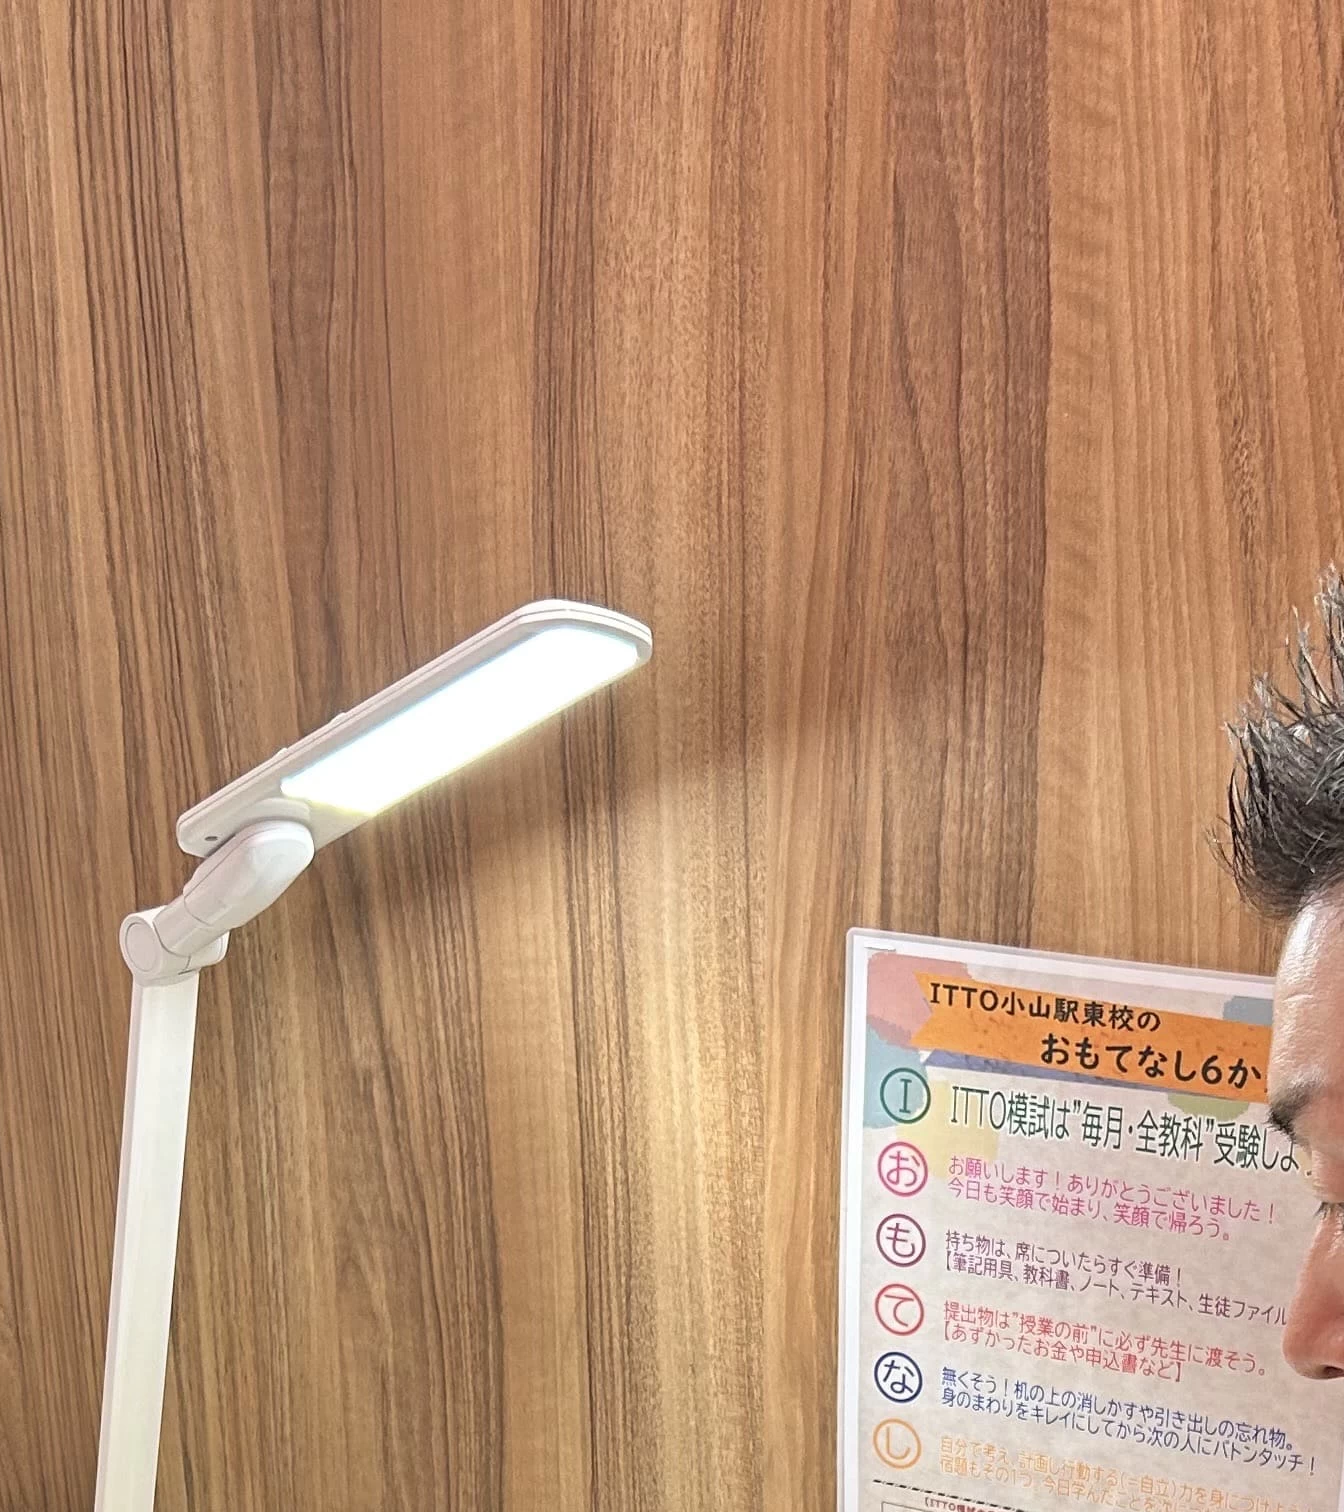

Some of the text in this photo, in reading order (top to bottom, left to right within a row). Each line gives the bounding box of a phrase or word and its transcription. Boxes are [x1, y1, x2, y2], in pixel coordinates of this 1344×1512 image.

[929, 981, 1162, 1033] ITTO小山駅東校の
[1040, 1033, 1267, 1091] おもてなし6か
[950, 1085, 1312, 1176] ITTO模試は”毎月・全教科”受験しよ
[947, 1178, 1231, 1242] 今日も笑顔で始まり、笑顔で帰ろう。
[948, 1156, 1275, 1224] お願いします！ありがとうございました！
[945, 1230, 1182, 1289] 持ち物は、席についたらすぐ準備！
[940, 1387, 1316, 1477] 身のまわりをキレイにしてから次の人にバトンタッチ！
[941, 1366, 1293, 1453] 無くそう！机の上の消しかすや引き出しの忘れ物。
